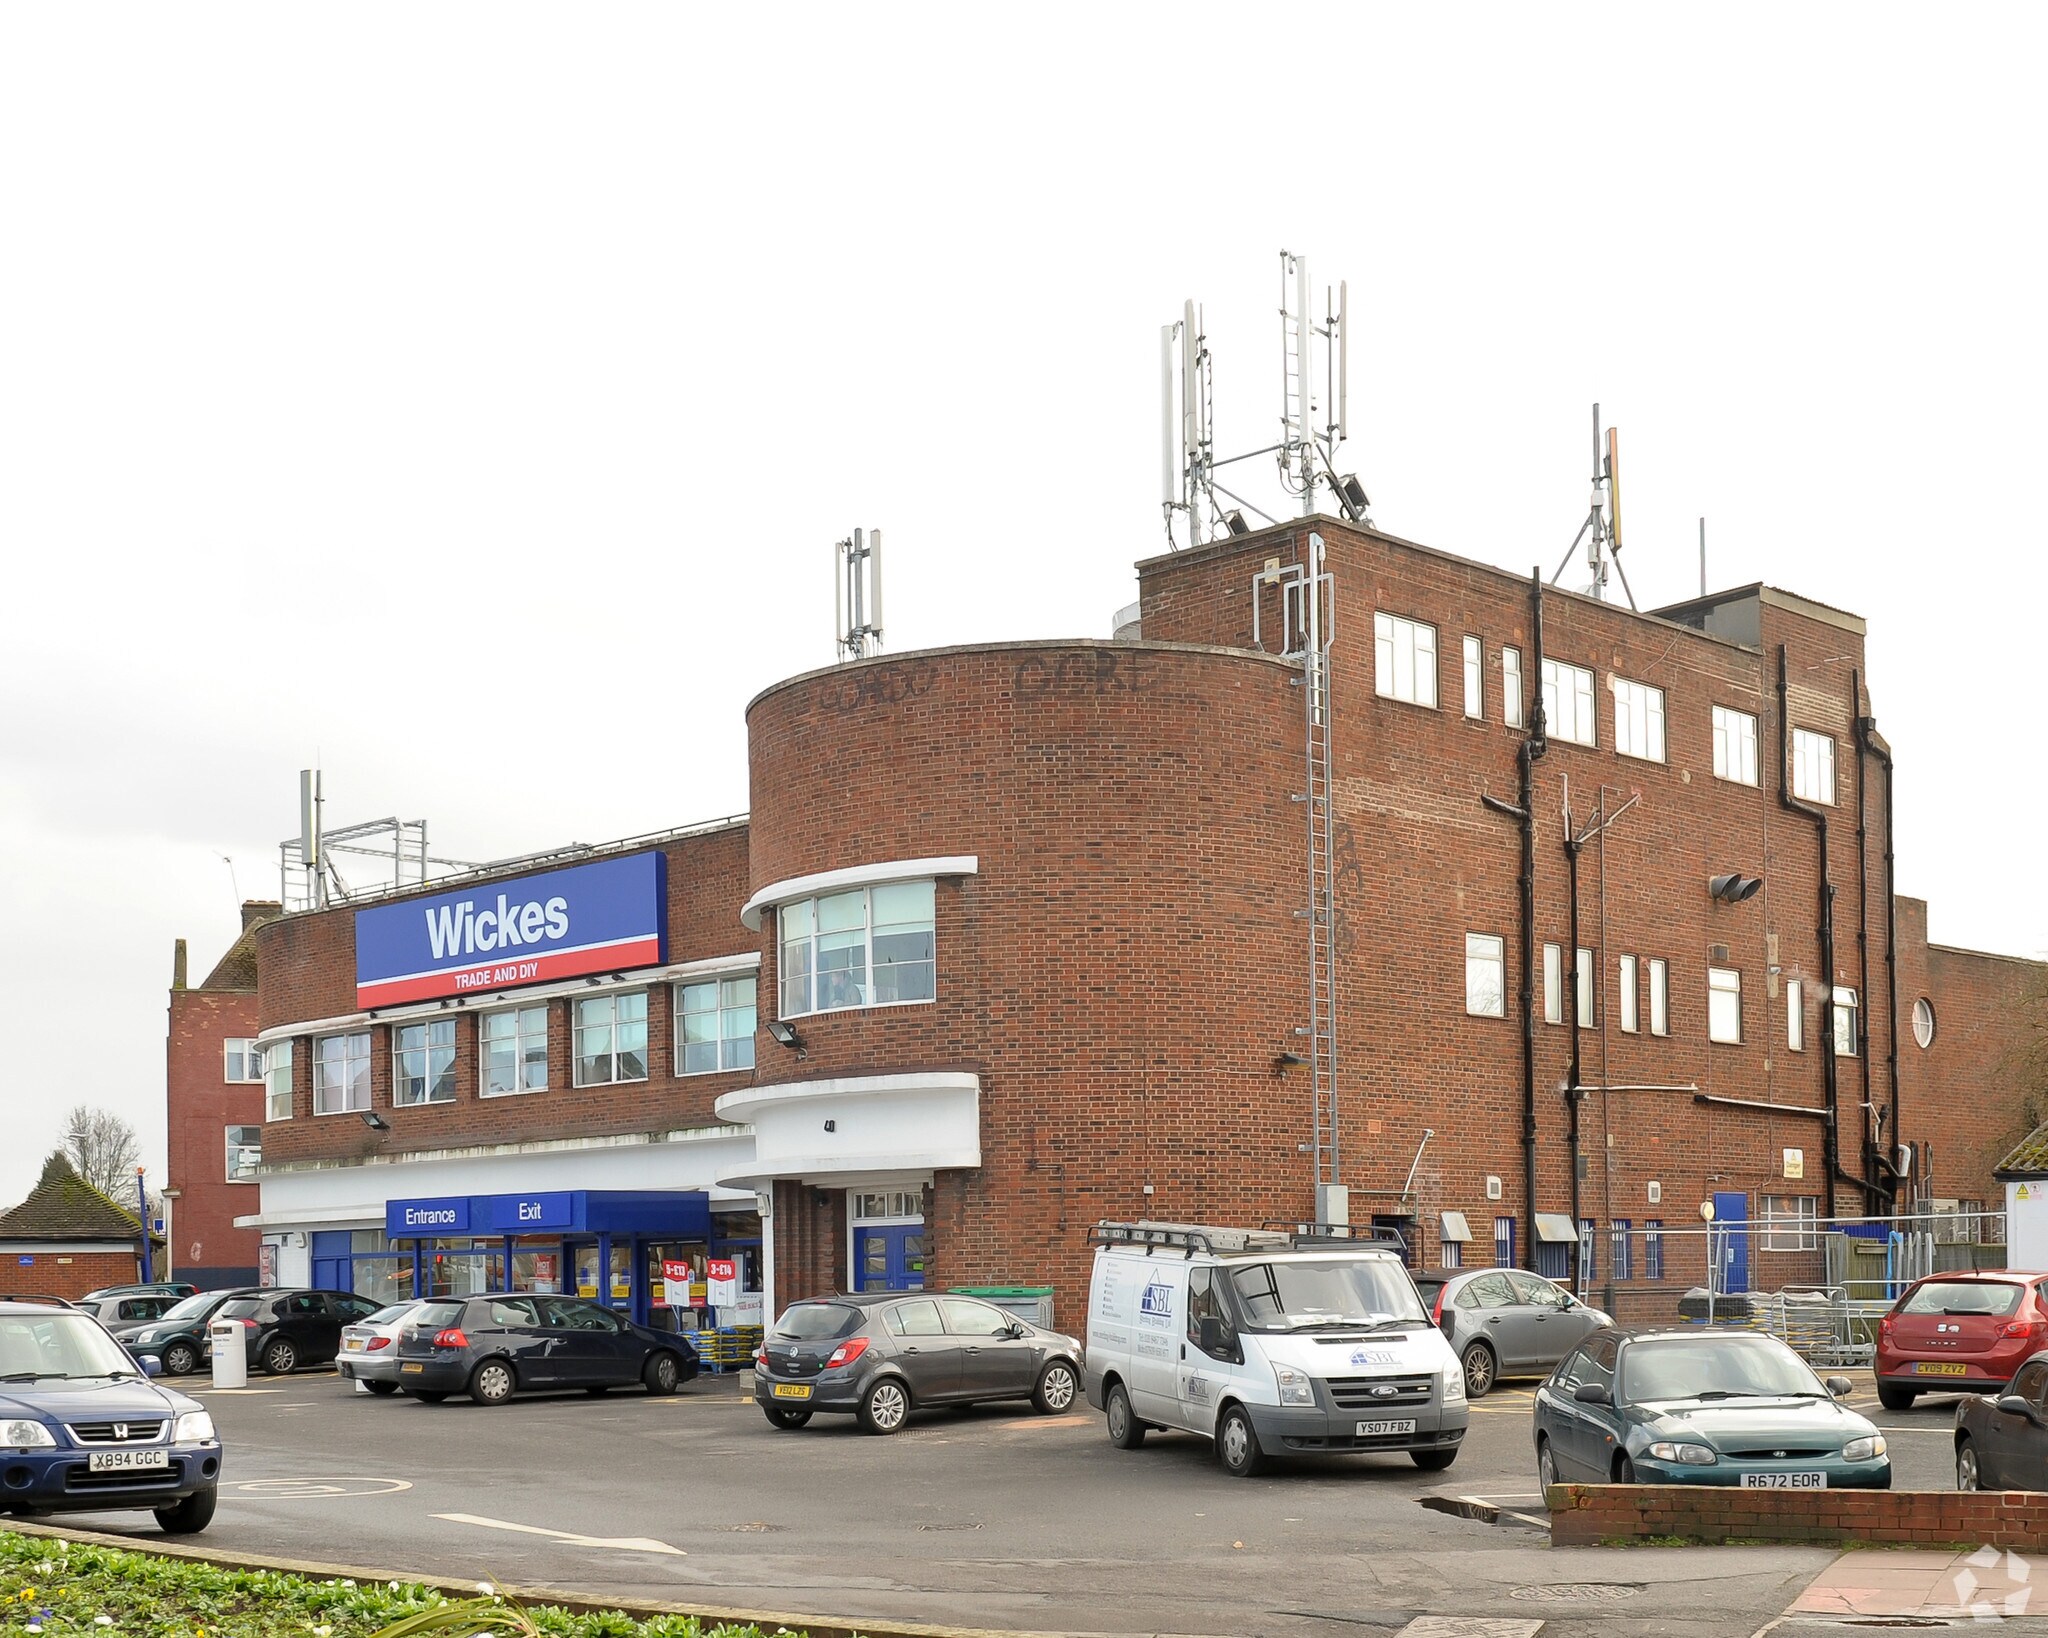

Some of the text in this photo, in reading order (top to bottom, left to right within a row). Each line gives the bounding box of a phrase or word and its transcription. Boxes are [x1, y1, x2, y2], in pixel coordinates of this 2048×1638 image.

[425, 894, 569, 960] Wickes
[454, 962, 539, 989] TRADE AND DIY
[405, 1208, 456, 1226] Entrance
[519, 1202, 542, 1221] Exit
[1151, 1287, 1173, 1313] SBL
[1365, 1352, 1401, 1363] SBL
[1945, 1364, 1964, 1374] ZVZ
[1361, 1421, 1411, 1433] YS07 FDZ
[96, 1451, 161, 1467] X894 GGC
[1748, 1473, 1821, 1488] R672 EOR
